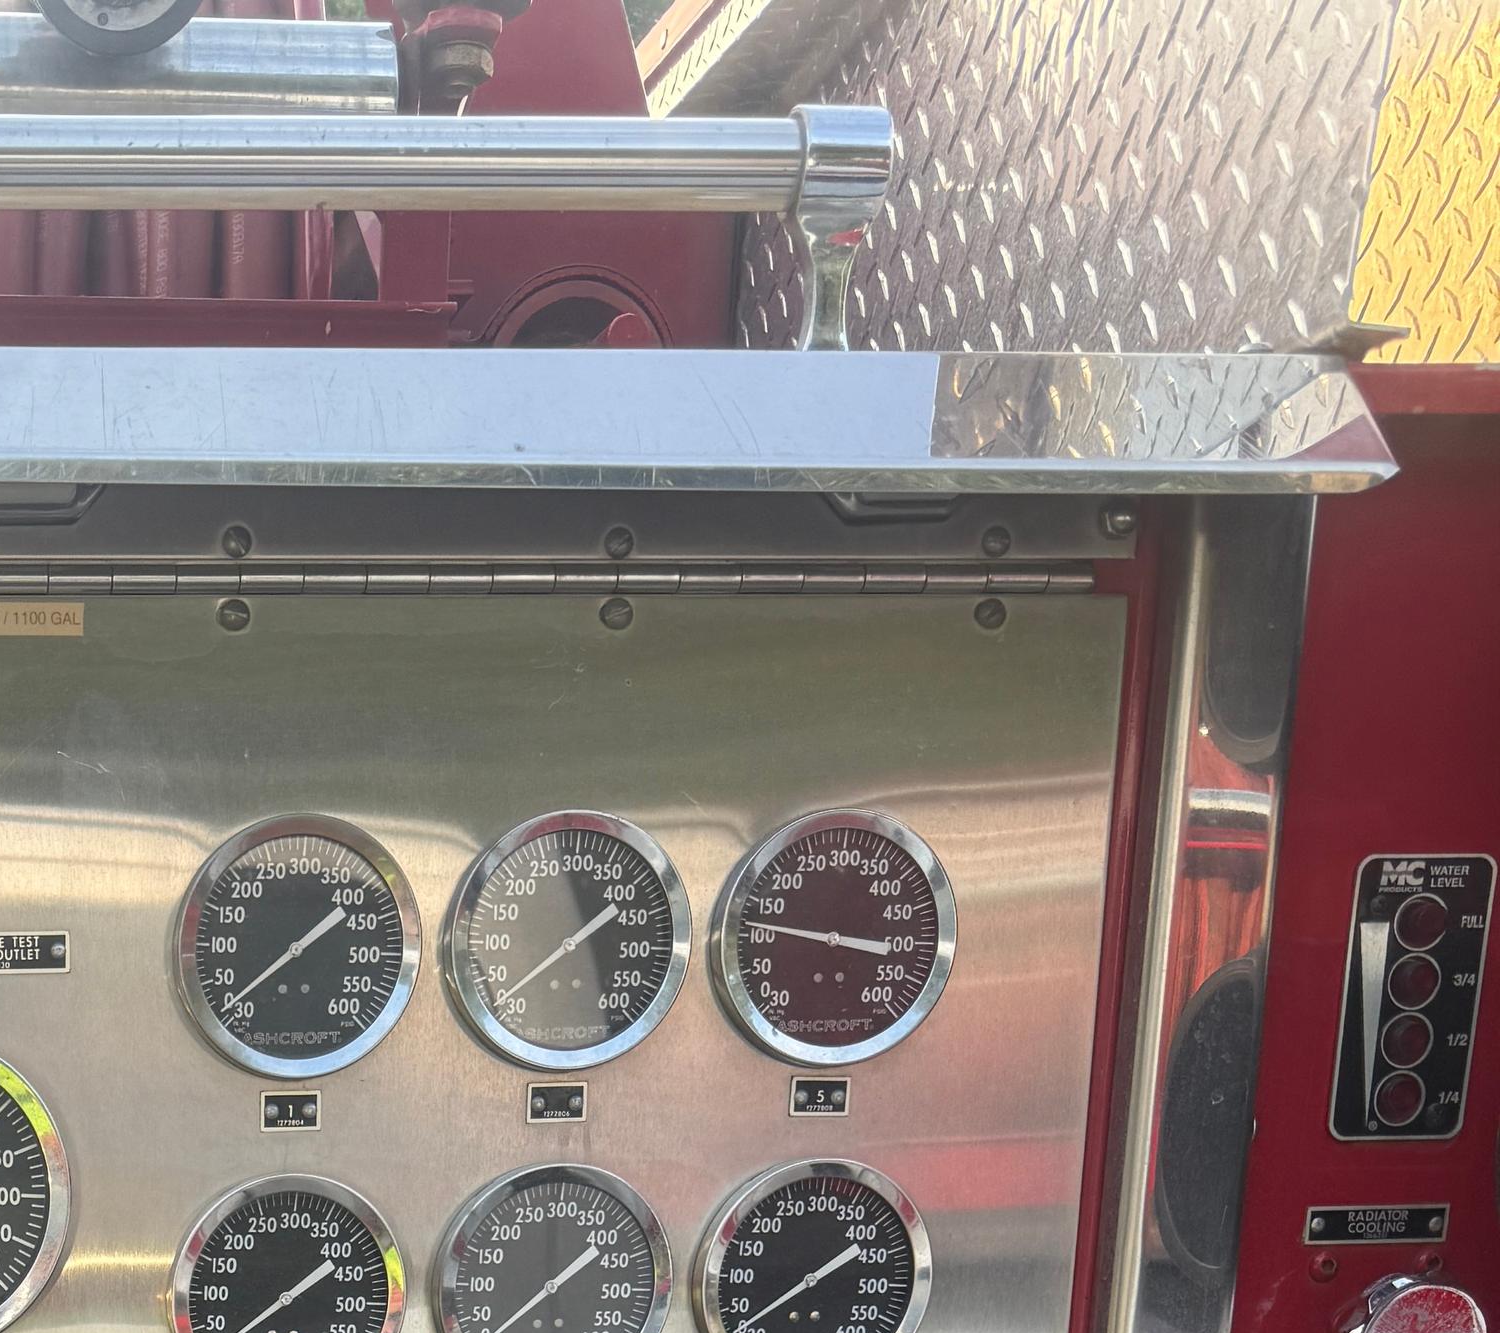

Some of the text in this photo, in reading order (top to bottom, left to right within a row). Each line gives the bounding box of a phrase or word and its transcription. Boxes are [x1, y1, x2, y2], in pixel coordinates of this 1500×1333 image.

[14, 611, 46, 625] 1100
[51, 612, 80, 625] GAL
[1380, 862, 1426, 886] MC
[1431, 865, 1469, 876] WATER
[1431, 877, 1465, 887] LEVEL
[1461, 916, 1484, 928] FULL
[13, 936, 40, 947] TEST
[1453, 975, 1475, 986] 3/4
[1446, 1035, 1468, 1046] 1/2
[816, 1090, 824, 1104] 5
[1438, 1092, 1459, 1104] 1/4
[288, 1104, 293, 1118] 1
[1348, 1210, 1409, 1221] RADIATOR
[1348, 1222, 1406, 1233] COOLING
